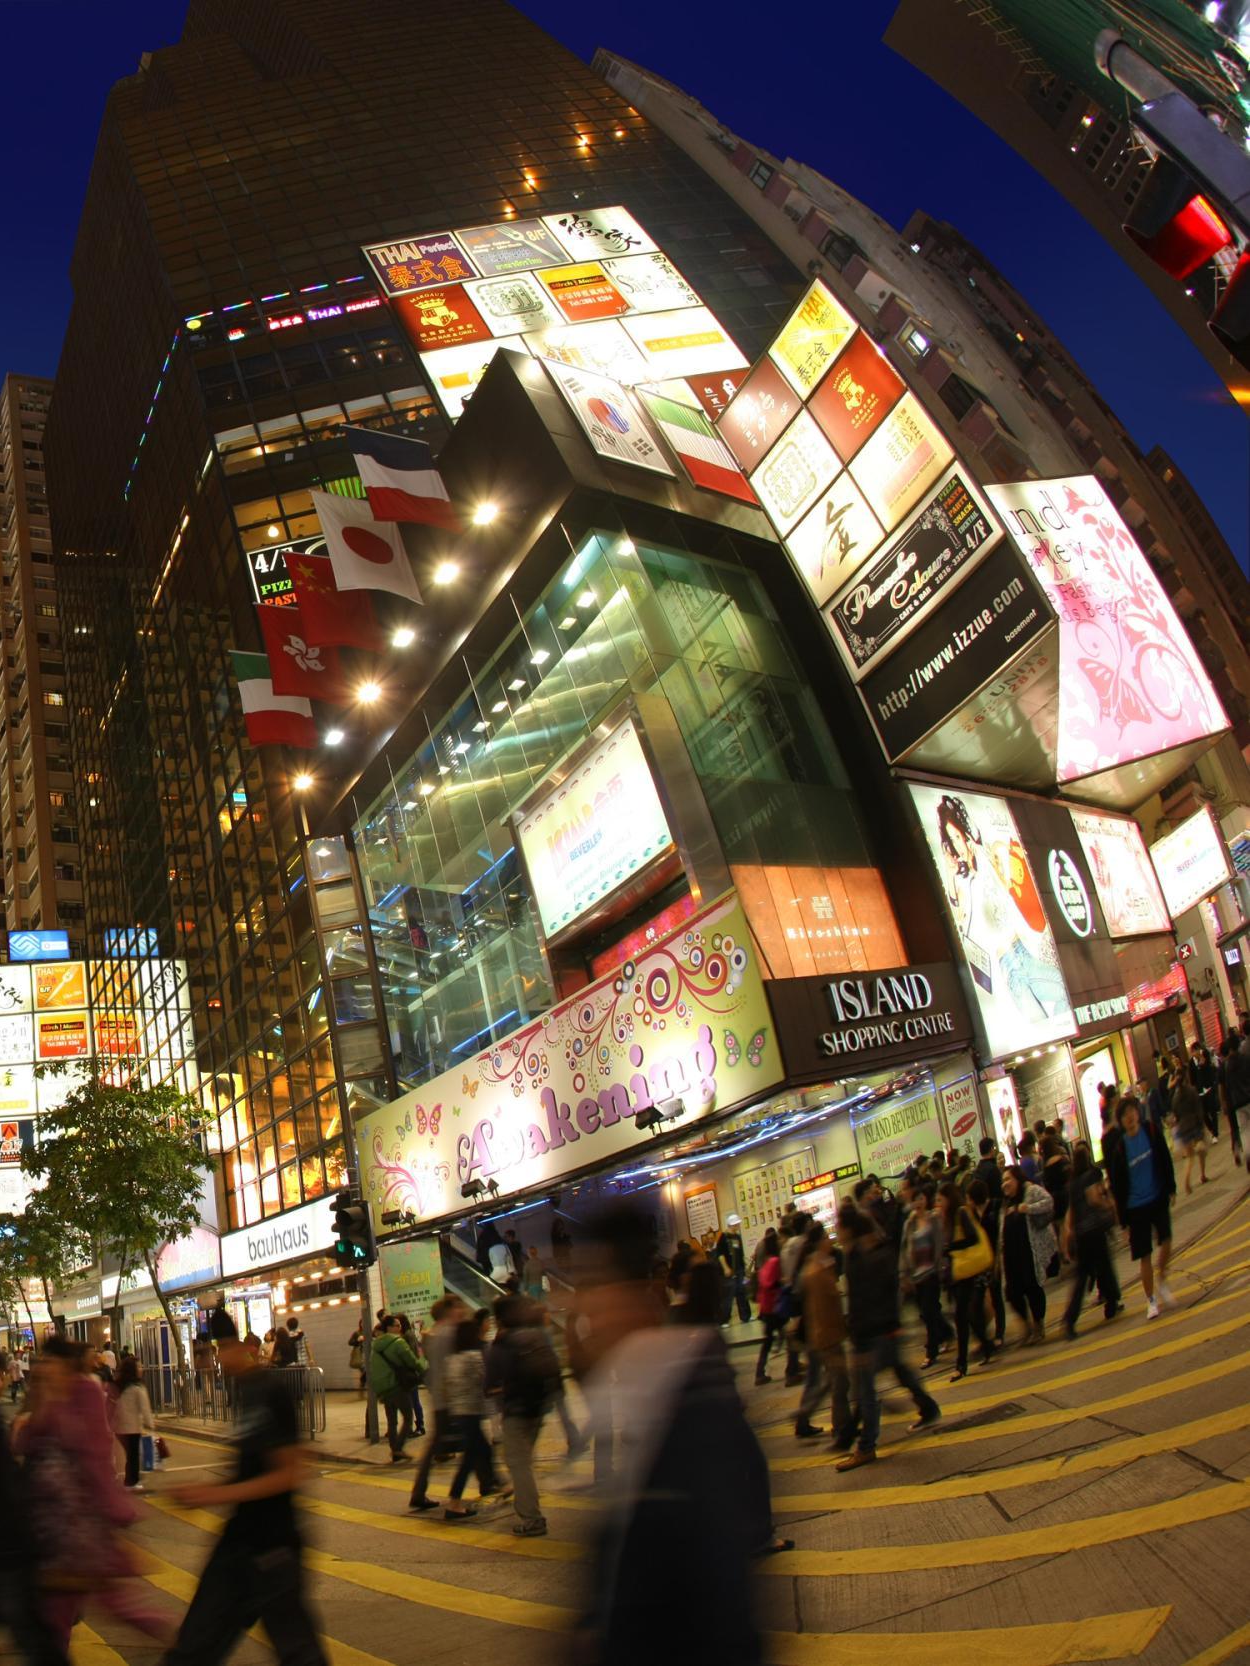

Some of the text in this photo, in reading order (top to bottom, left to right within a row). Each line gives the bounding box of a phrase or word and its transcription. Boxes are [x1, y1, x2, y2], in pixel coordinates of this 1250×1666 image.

[370, 242, 423, 267] THAI
[419, 241, 456, 254] Perfect
[386, 255, 470, 289] 泰式食
[308, 306, 342, 320] THAI
[798, 290, 826, 327] THAI
[938, 479, 958, 501] PIZZA
[948, 494, 968, 517] PARTY
[953, 502, 974, 527] SNACK
[966, 519, 988, 550] 4/F
[260, 579, 293, 596] PIZZ
[890, 547, 951, 610] Colours
[264, 592, 297, 606] PAST
[1004, 609, 1037, 643] basement
[878, 577, 1025, 721] http://www.izzue.com
[827, 973, 934, 1023] ISLAND
[822, 1012, 955, 1056] SHOPPING CENTRE
[456, 1023, 717, 1184] Awakening
[945, 1085, 970, 1103] NOW
[948, 1095, 974, 1116] SHOWING
[863, 1116, 892, 1146] ISLAND
[891, 1100, 931, 1136] BEVERLEY
[247, 1222, 310, 1262] bauhaus
